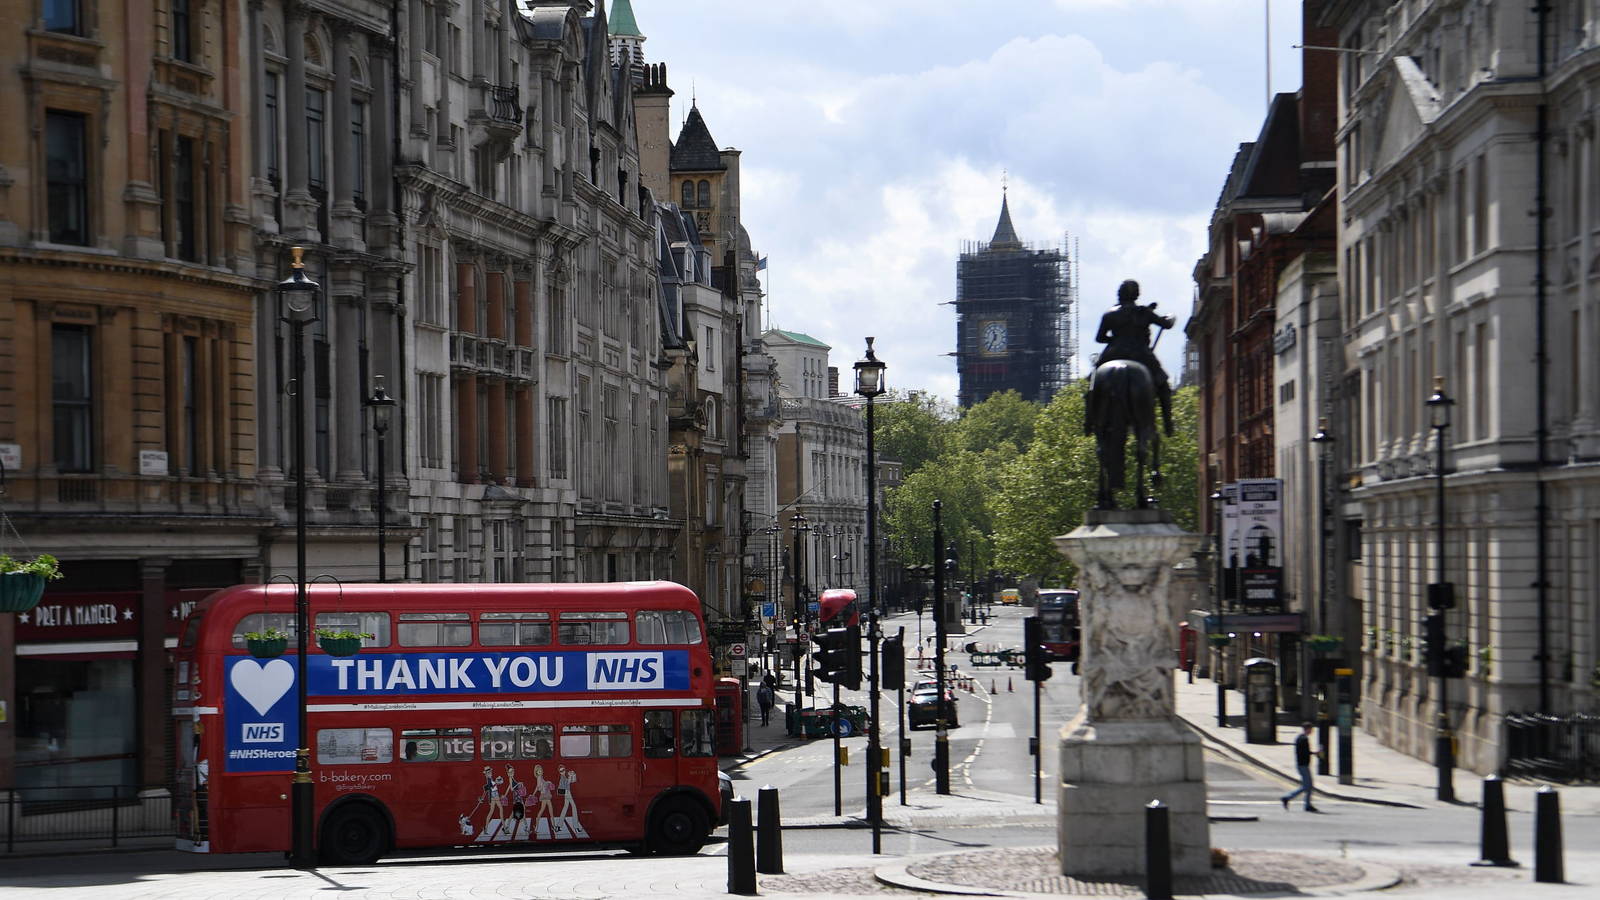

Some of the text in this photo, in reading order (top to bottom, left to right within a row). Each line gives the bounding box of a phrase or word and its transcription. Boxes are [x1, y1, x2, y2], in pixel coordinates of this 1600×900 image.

[35, 604, 118, 627] PRET A MANGER
[331, 656, 564, 690] THANK YOU
[593, 657, 658, 683] NHS
[246, 726, 281, 740] NHS
[229, 749, 298, 759] #NHSHeroes
[320, 770, 392, 784] b-bakery.com
